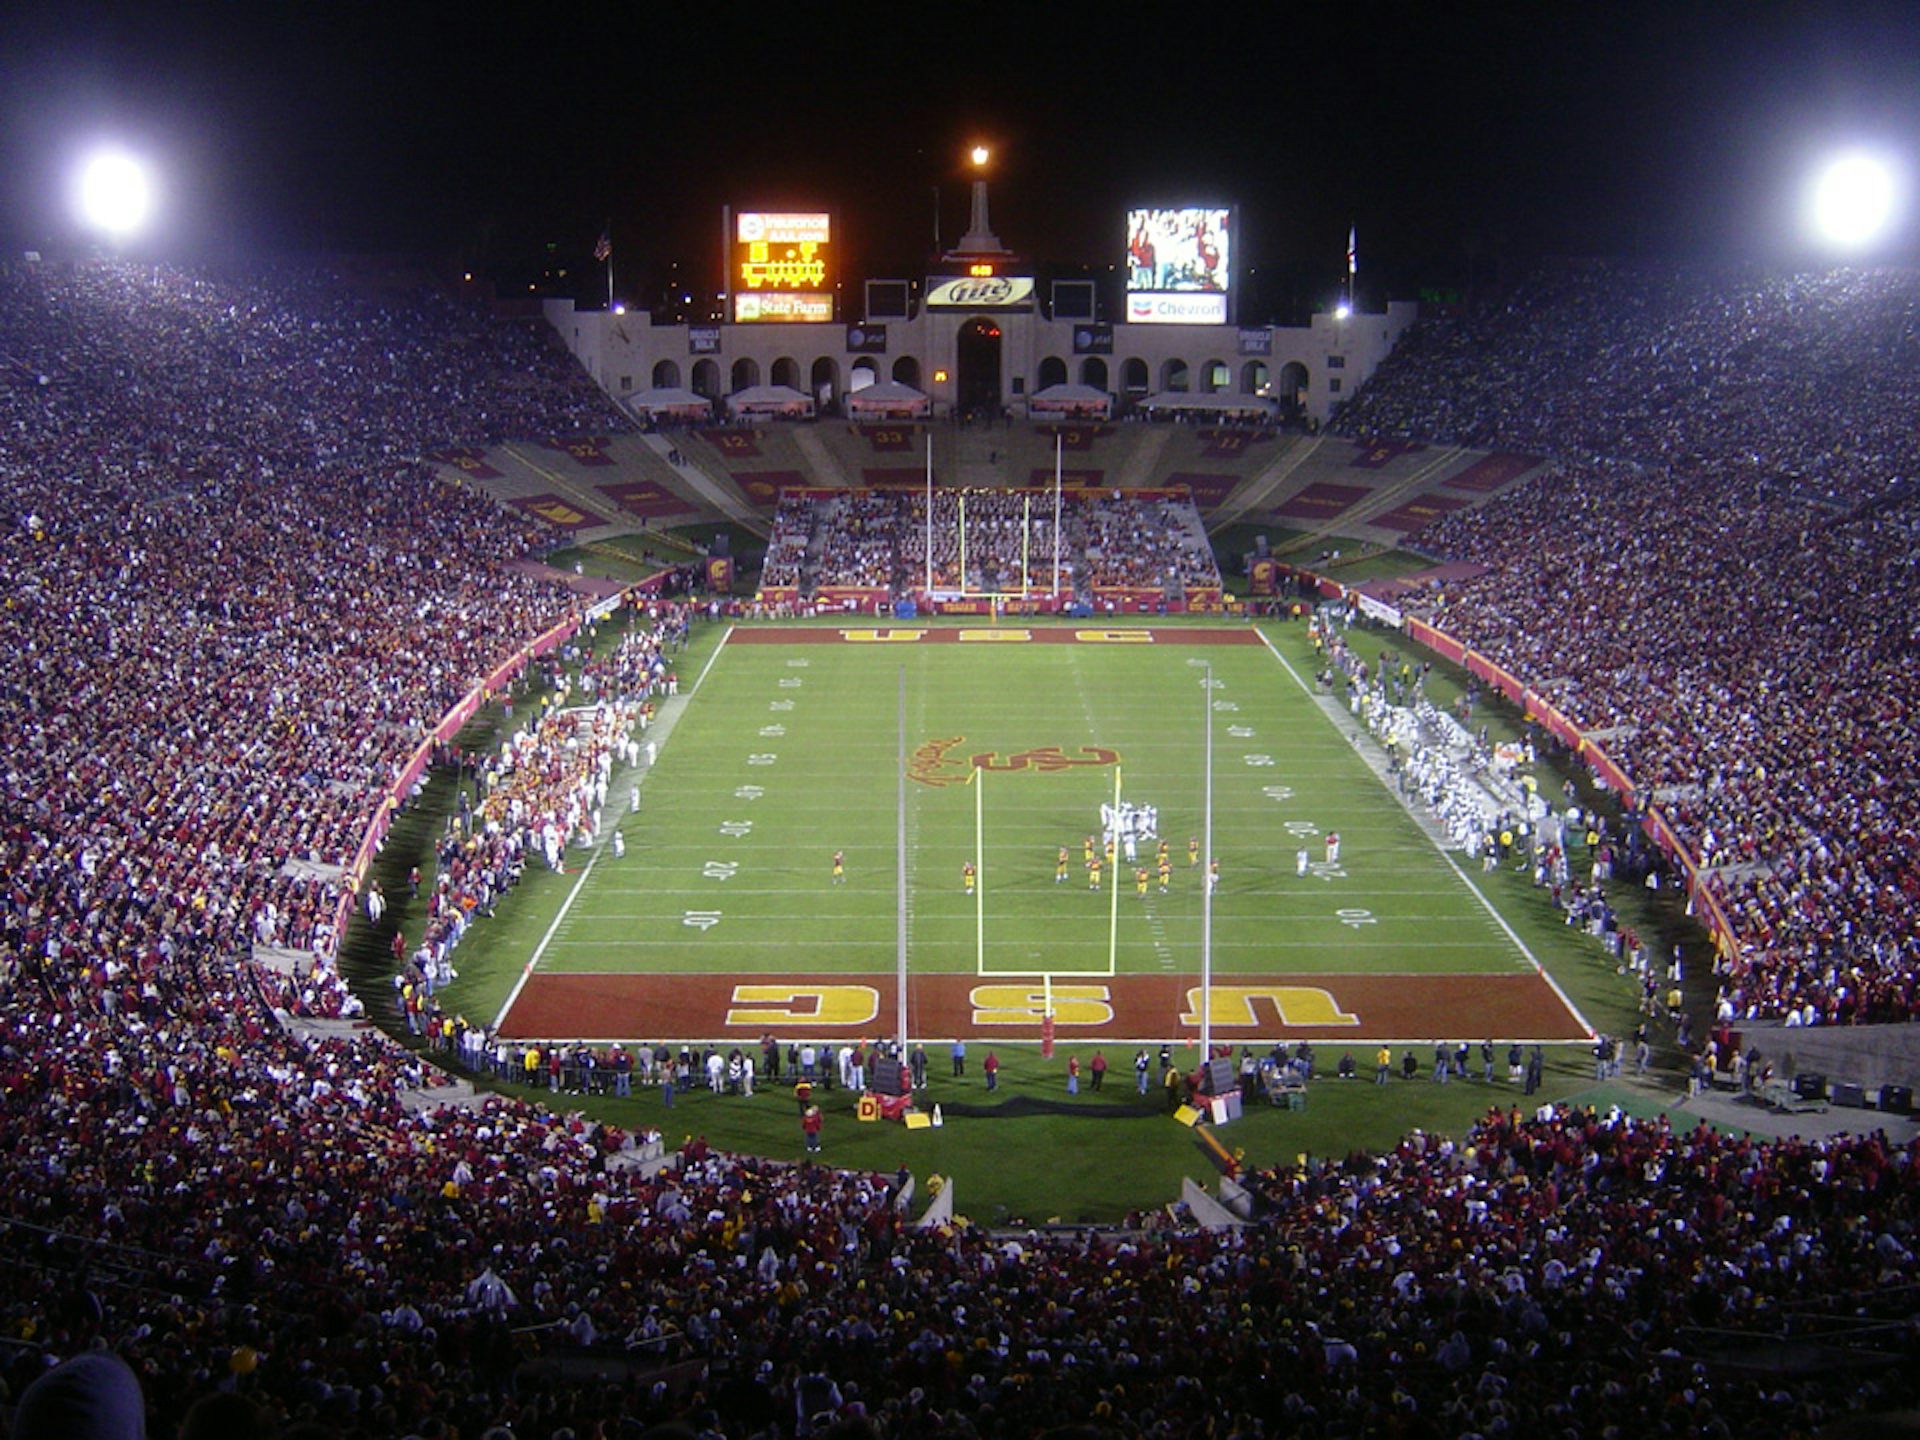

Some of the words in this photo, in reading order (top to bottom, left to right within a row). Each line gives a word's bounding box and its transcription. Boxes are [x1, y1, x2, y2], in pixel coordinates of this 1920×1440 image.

[761, 298, 790, 314] State
[793, 299, 827, 314] Farm
[1157, 301, 1221, 316] Chevron
[721, 435, 748, 449] 12
[875, 432, 903, 444] 33
[683, 911, 722, 926] 10
[1335, 908, 1378, 925] 10
[861, 1102, 874, 1116] D
